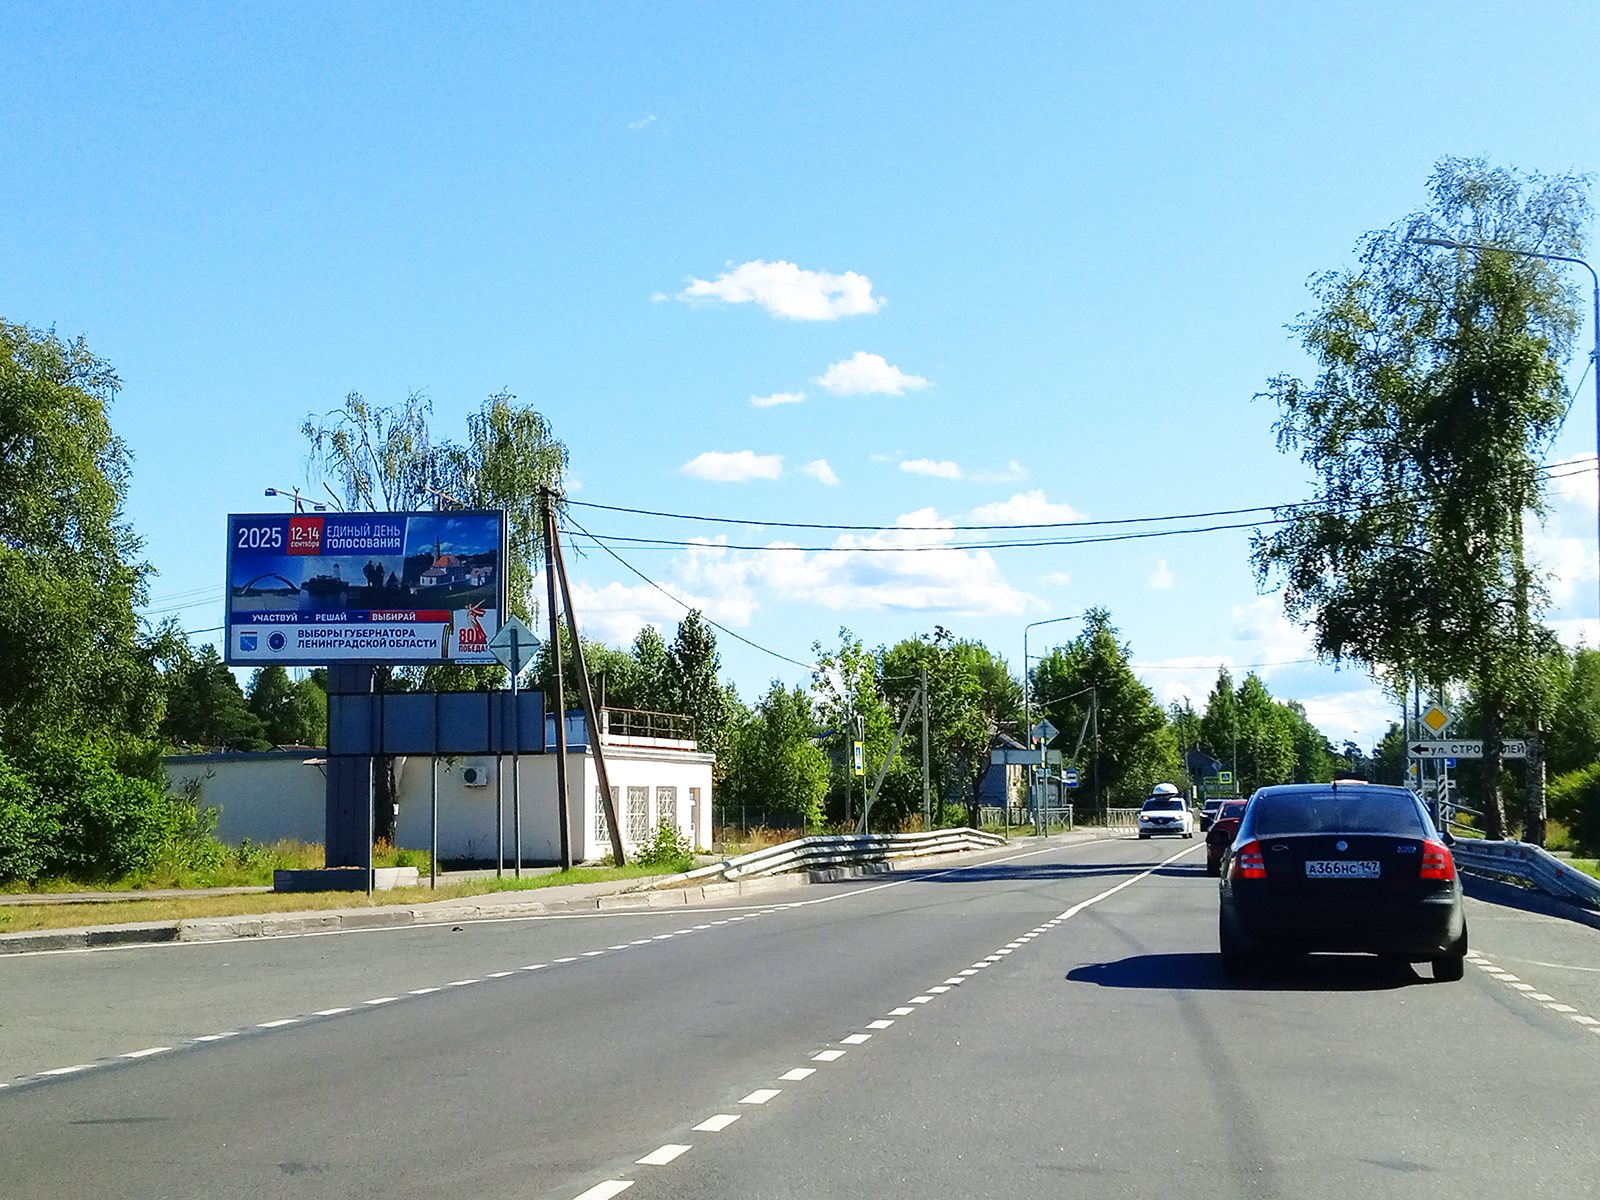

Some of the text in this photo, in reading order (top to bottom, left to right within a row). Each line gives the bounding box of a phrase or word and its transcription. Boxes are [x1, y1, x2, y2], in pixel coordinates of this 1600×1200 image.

[291, 526, 320, 540] 12-14
[327, 523, 401, 538] ЕДИНЫЙ ДЕНЬ
[238, 527, 282, 548] 2025
[252, 612, 298, 622] УЧАСТВУЙ
[315, 612, 347, 621] РЕШАЙ
[372, 612, 416, 621] ВЫБИРАЙ
[297, 629, 416, 638] ВЫБОРЫ ГУБЕРНАТОРА
[459, 628, 475, 643] 80
[297, 638, 437, 649] ЛЕНИНГРАДСКОЙ ОБЛАСТИ
[1450, 743, 1525, 754] СТРОЛЕЙ
